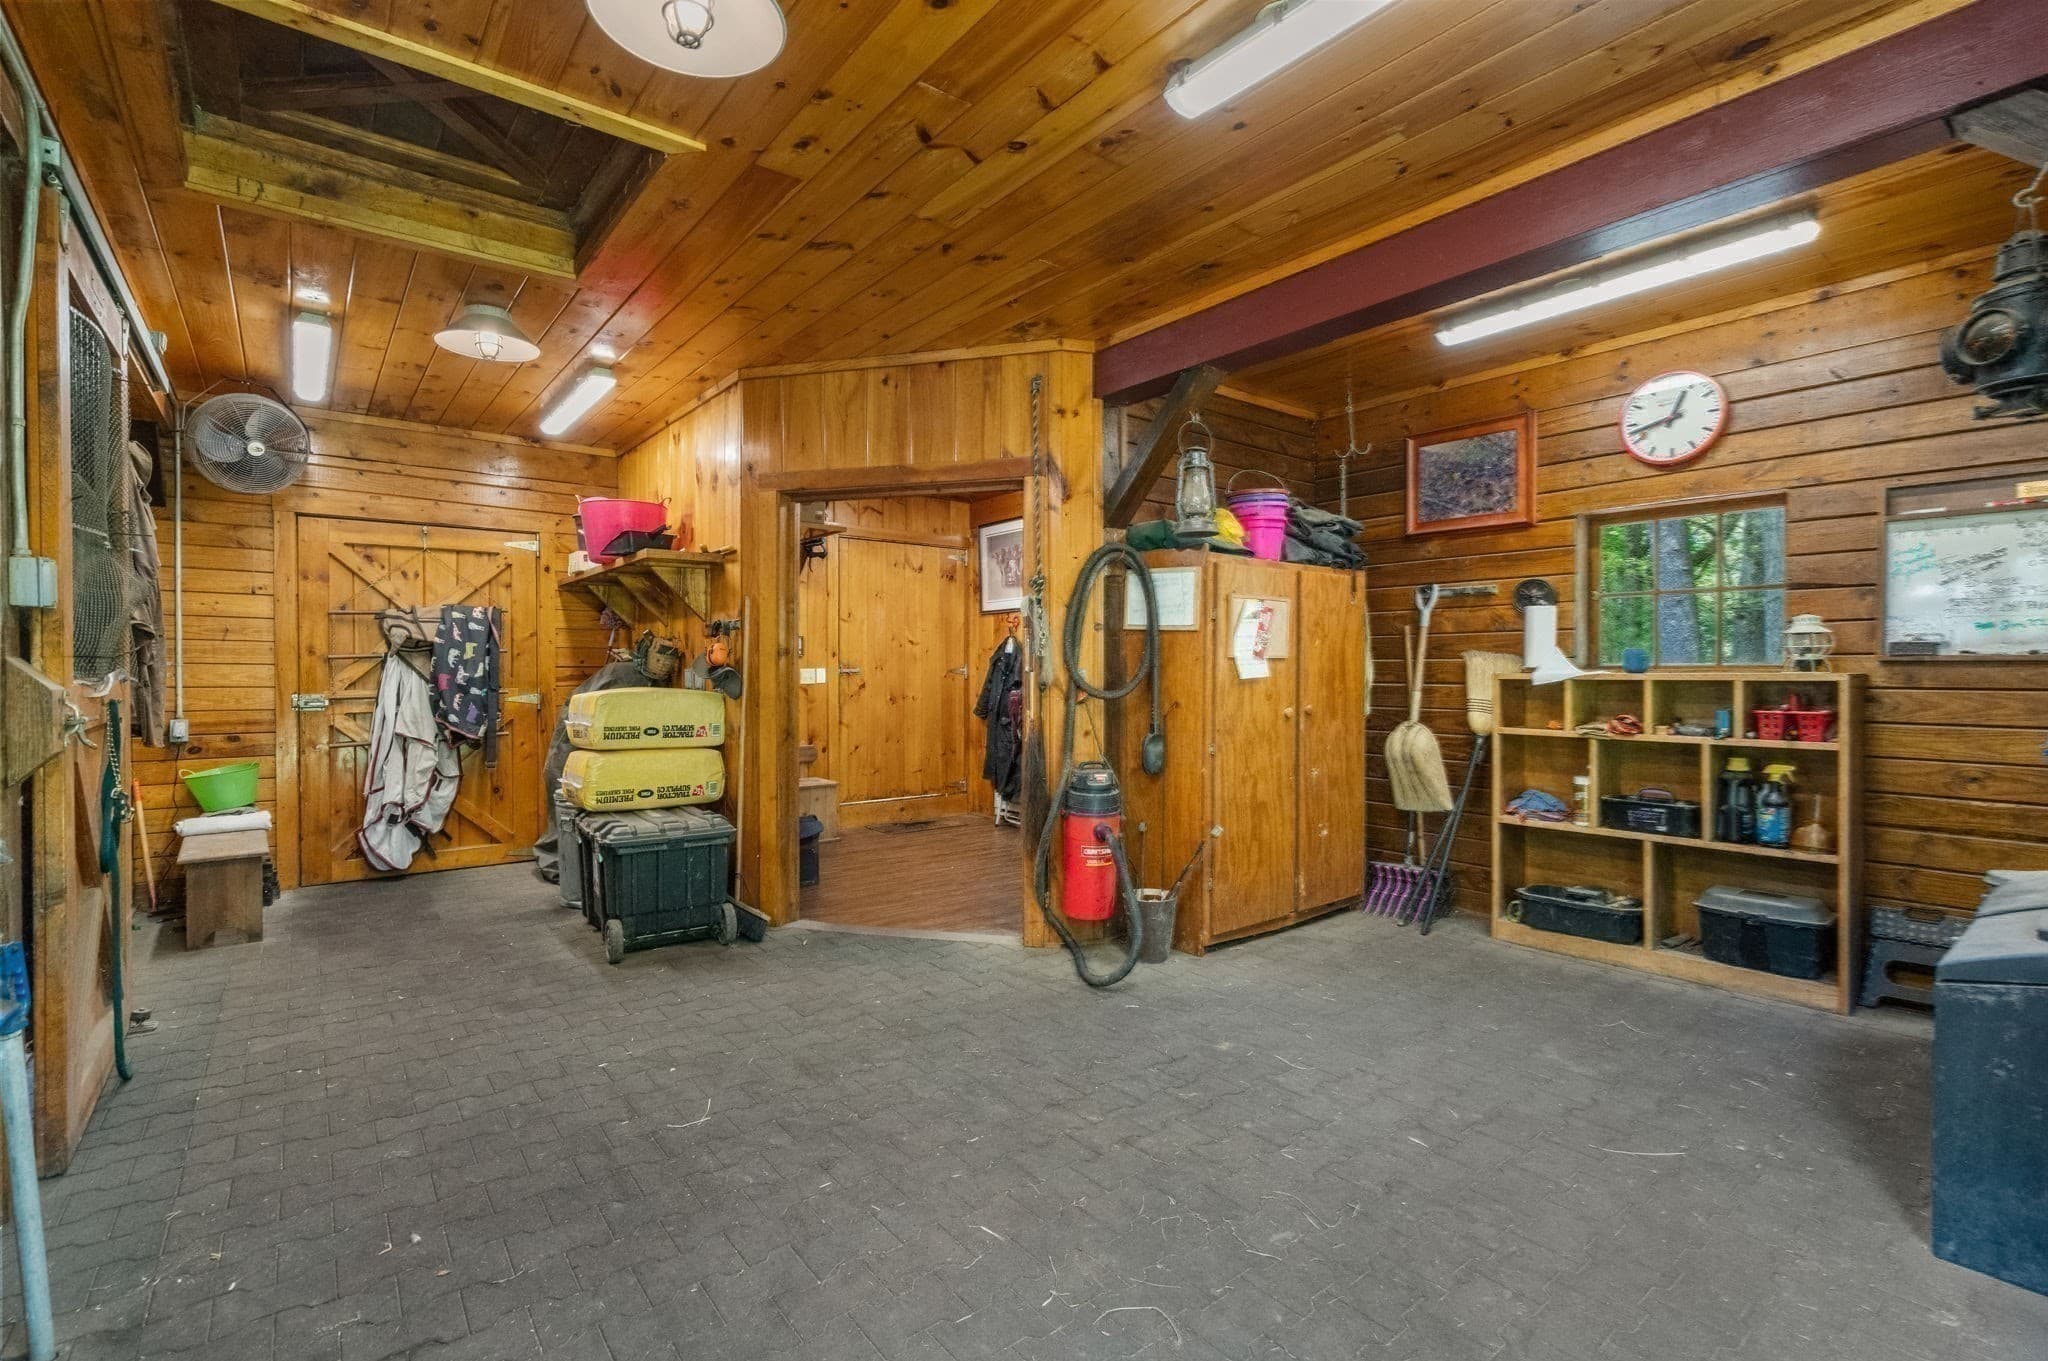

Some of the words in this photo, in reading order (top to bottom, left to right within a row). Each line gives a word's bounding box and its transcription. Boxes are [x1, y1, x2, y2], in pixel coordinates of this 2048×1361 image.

[603, 732, 640, 740] PREMIUM
[657, 791, 690, 799] TRACTOR
[596, 795, 634, 804] PREMIUM
